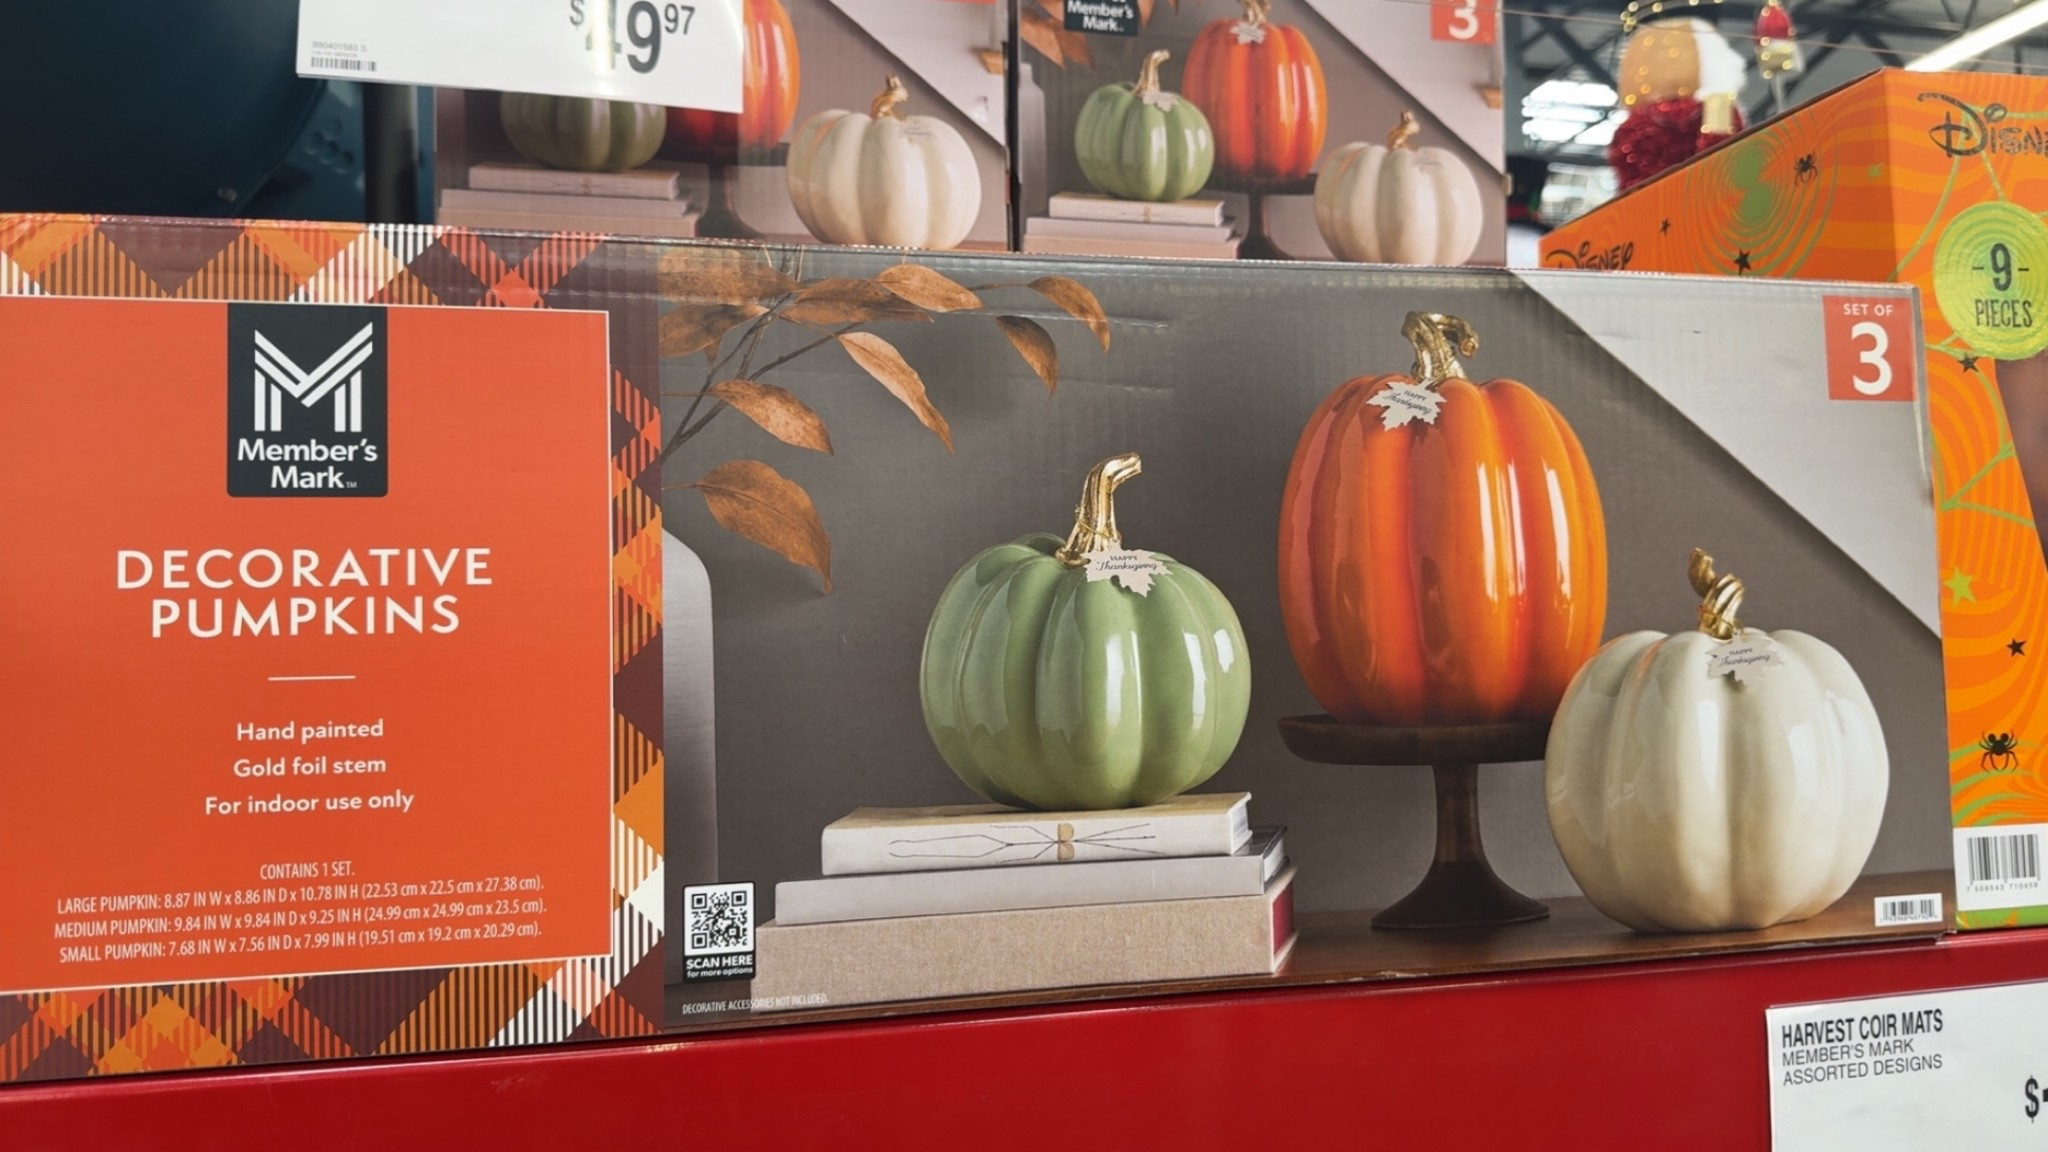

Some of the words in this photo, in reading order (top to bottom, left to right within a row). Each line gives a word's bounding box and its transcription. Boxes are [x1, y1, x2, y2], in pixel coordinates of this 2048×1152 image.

[664, 3, 696, 35] 97
[1067, 0, 1134, 19] Member's
[1448, 0, 1479, 40] 3
[1082, 15, 1119, 32] Mark
[1917, 91, 2048, 159] DISN
[1843, 303, 1869, 316] SET
[1874, 304, 1894, 317] OF
[1974, 299, 2034, 328] PIECES
[1850, 321, 1893, 396] 3
[237, 438, 378, 462] Member's
[271, 465, 345, 489] Mark
[117, 547, 493, 590] DECORATIVE
[1096, 561, 1157, 572] Thanksgiving
[152, 594, 460, 639] PUMPKINS
[236, 721, 295, 742] Hand
[301, 718, 384, 745] painted
[233, 757, 286, 778] Gold
[292, 755, 327, 776] foil
[333, 758, 387, 774] stem
[205, 796, 242, 815] For
[248, 793, 320, 813] indoor
[325, 796, 362, 810] use
[368, 789, 415, 813] only
[260, 862, 319, 880] CONTAINS
[323, 863, 328, 877] 1
[331, 861, 356, 877] SET.
[57, 897, 97, 914] LARGE
[101, 894, 161, 912] PUMPKIN:
[164, 893, 190, 908] 8.87
[194, 892, 206, 907] IN
[209, 891, 222, 906] W
[225, 895, 232, 905] x
[234, 889, 260, 904] 8.86
[263, 888, 275, 903] IN
[279, 888, 287, 902] D
[290, 891, 297, 901] x
[300, 886, 332, 901] 10.78
[335, 885, 347, 899] IN
[350, 884, 358, 898] H
[362, 882, 398, 900] (22.53
[401, 885, 418, 897] cm
[420, 884, 427, 895] x
[430, 880, 454, 895] 22.5
[457, 881, 474, 893] cm
[476, 882, 483, 892] x
[485, 877, 517, 892] 27.38
[519, 875, 544, 891] cm).
[55, 920, 107, 938] MEDIUM
[110, 918, 171, 935] PUMPKIN:
[174, 916, 200, 932] 9.84
[204, 916, 216, 930] IN
[219, 914, 232, 929] W
[235, 917, 241, 928] x
[244, 913, 270, 928] 9.84
[273, 911, 286, 926] IN
[289, 911, 297, 925] D
[300, 915, 307, 925] x
[309, 909, 334, 925] 9.25
[338, 909, 350, 923] IN
[353, 908, 361, 922] H
[365, 905, 401, 924] (24.99
[403, 908, 421, 920] cm
[423, 907, 430, 918] x
[433, 902, 464, 919] 24.99
[466, 904, 483, 916] cm
[486, 905, 493, 915] x
[495, 899, 519, 915] 23.5
[522, 898, 547, 914] cm).
[59, 945, 101, 963] SMALL
[105, 942, 165, 960] PUMPKIN:
[169, 941, 195, 956] 7.68
[199, 940, 210, 954] IN
[214, 938, 227, 953] W
[229, 942, 236, 952] x
[239, 937, 265, 952] 7.56
[268, 936, 280, 950] IN
[283, 935, 292, 949] D
[294, 938, 301, 949] x
[304, 933, 330, 948] 7.99
[333, 932, 345, 947] IN
[348, 931, 355, 946] H
[359, 929, 395, 947] (19.51
[398, 931, 415, 943] cm
[418, 931, 425, 942] x
[428, 926, 452, 941] 19.2
[454, 927, 471, 939] cm
[474, 928, 481, 938] x
[483, 923, 515, 939] 20.29
[517, 921, 542, 937] cm).
[686, 958, 720, 970] SCAN
[722, 954, 753, 967] HERE
[687, 970, 699, 978] for
[700, 968, 721, 977] more
[723, 967, 753, 977] options
[682, 1001, 727, 1015] DECORATIVE
[728, 997, 775, 1011] ACCESSORIES
[775, 996, 790, 1007] NOT
[1781, 1017, 1855, 1048] HARVEST
[1859, 1013, 1897, 1041] COIR
[1901, 1008, 1943, 1035] MATS
[1782, 1043, 1864, 1066] MEMBER'S
[1869, 1038, 1915, 1057] MARK
[1783, 1063, 1869, 1086] ASSORTED
[1873, 1054, 1943, 1076] DESIGNS
